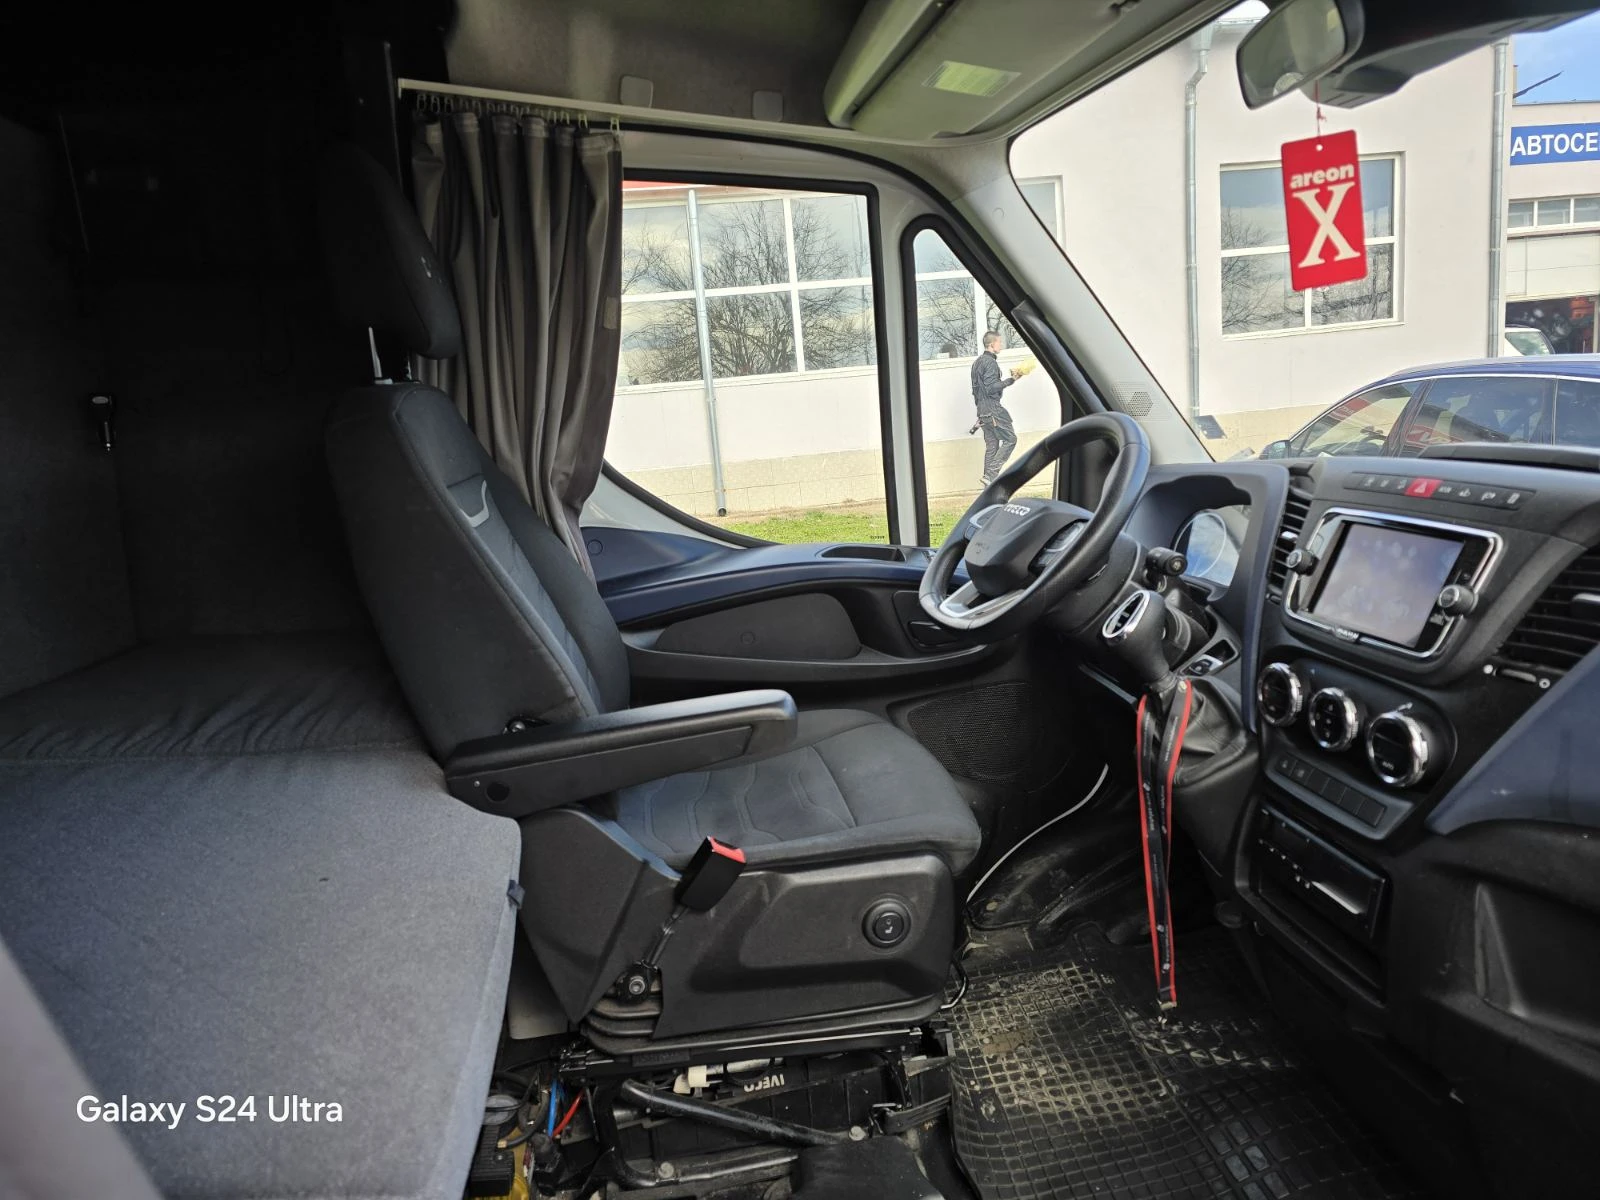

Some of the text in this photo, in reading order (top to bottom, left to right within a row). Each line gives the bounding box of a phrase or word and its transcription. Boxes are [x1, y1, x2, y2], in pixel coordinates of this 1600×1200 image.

[1510, 132, 1599, 157] АВТОСЕ
[1290, 164, 1355, 189] areon
[1292, 181, 1361, 268] X
